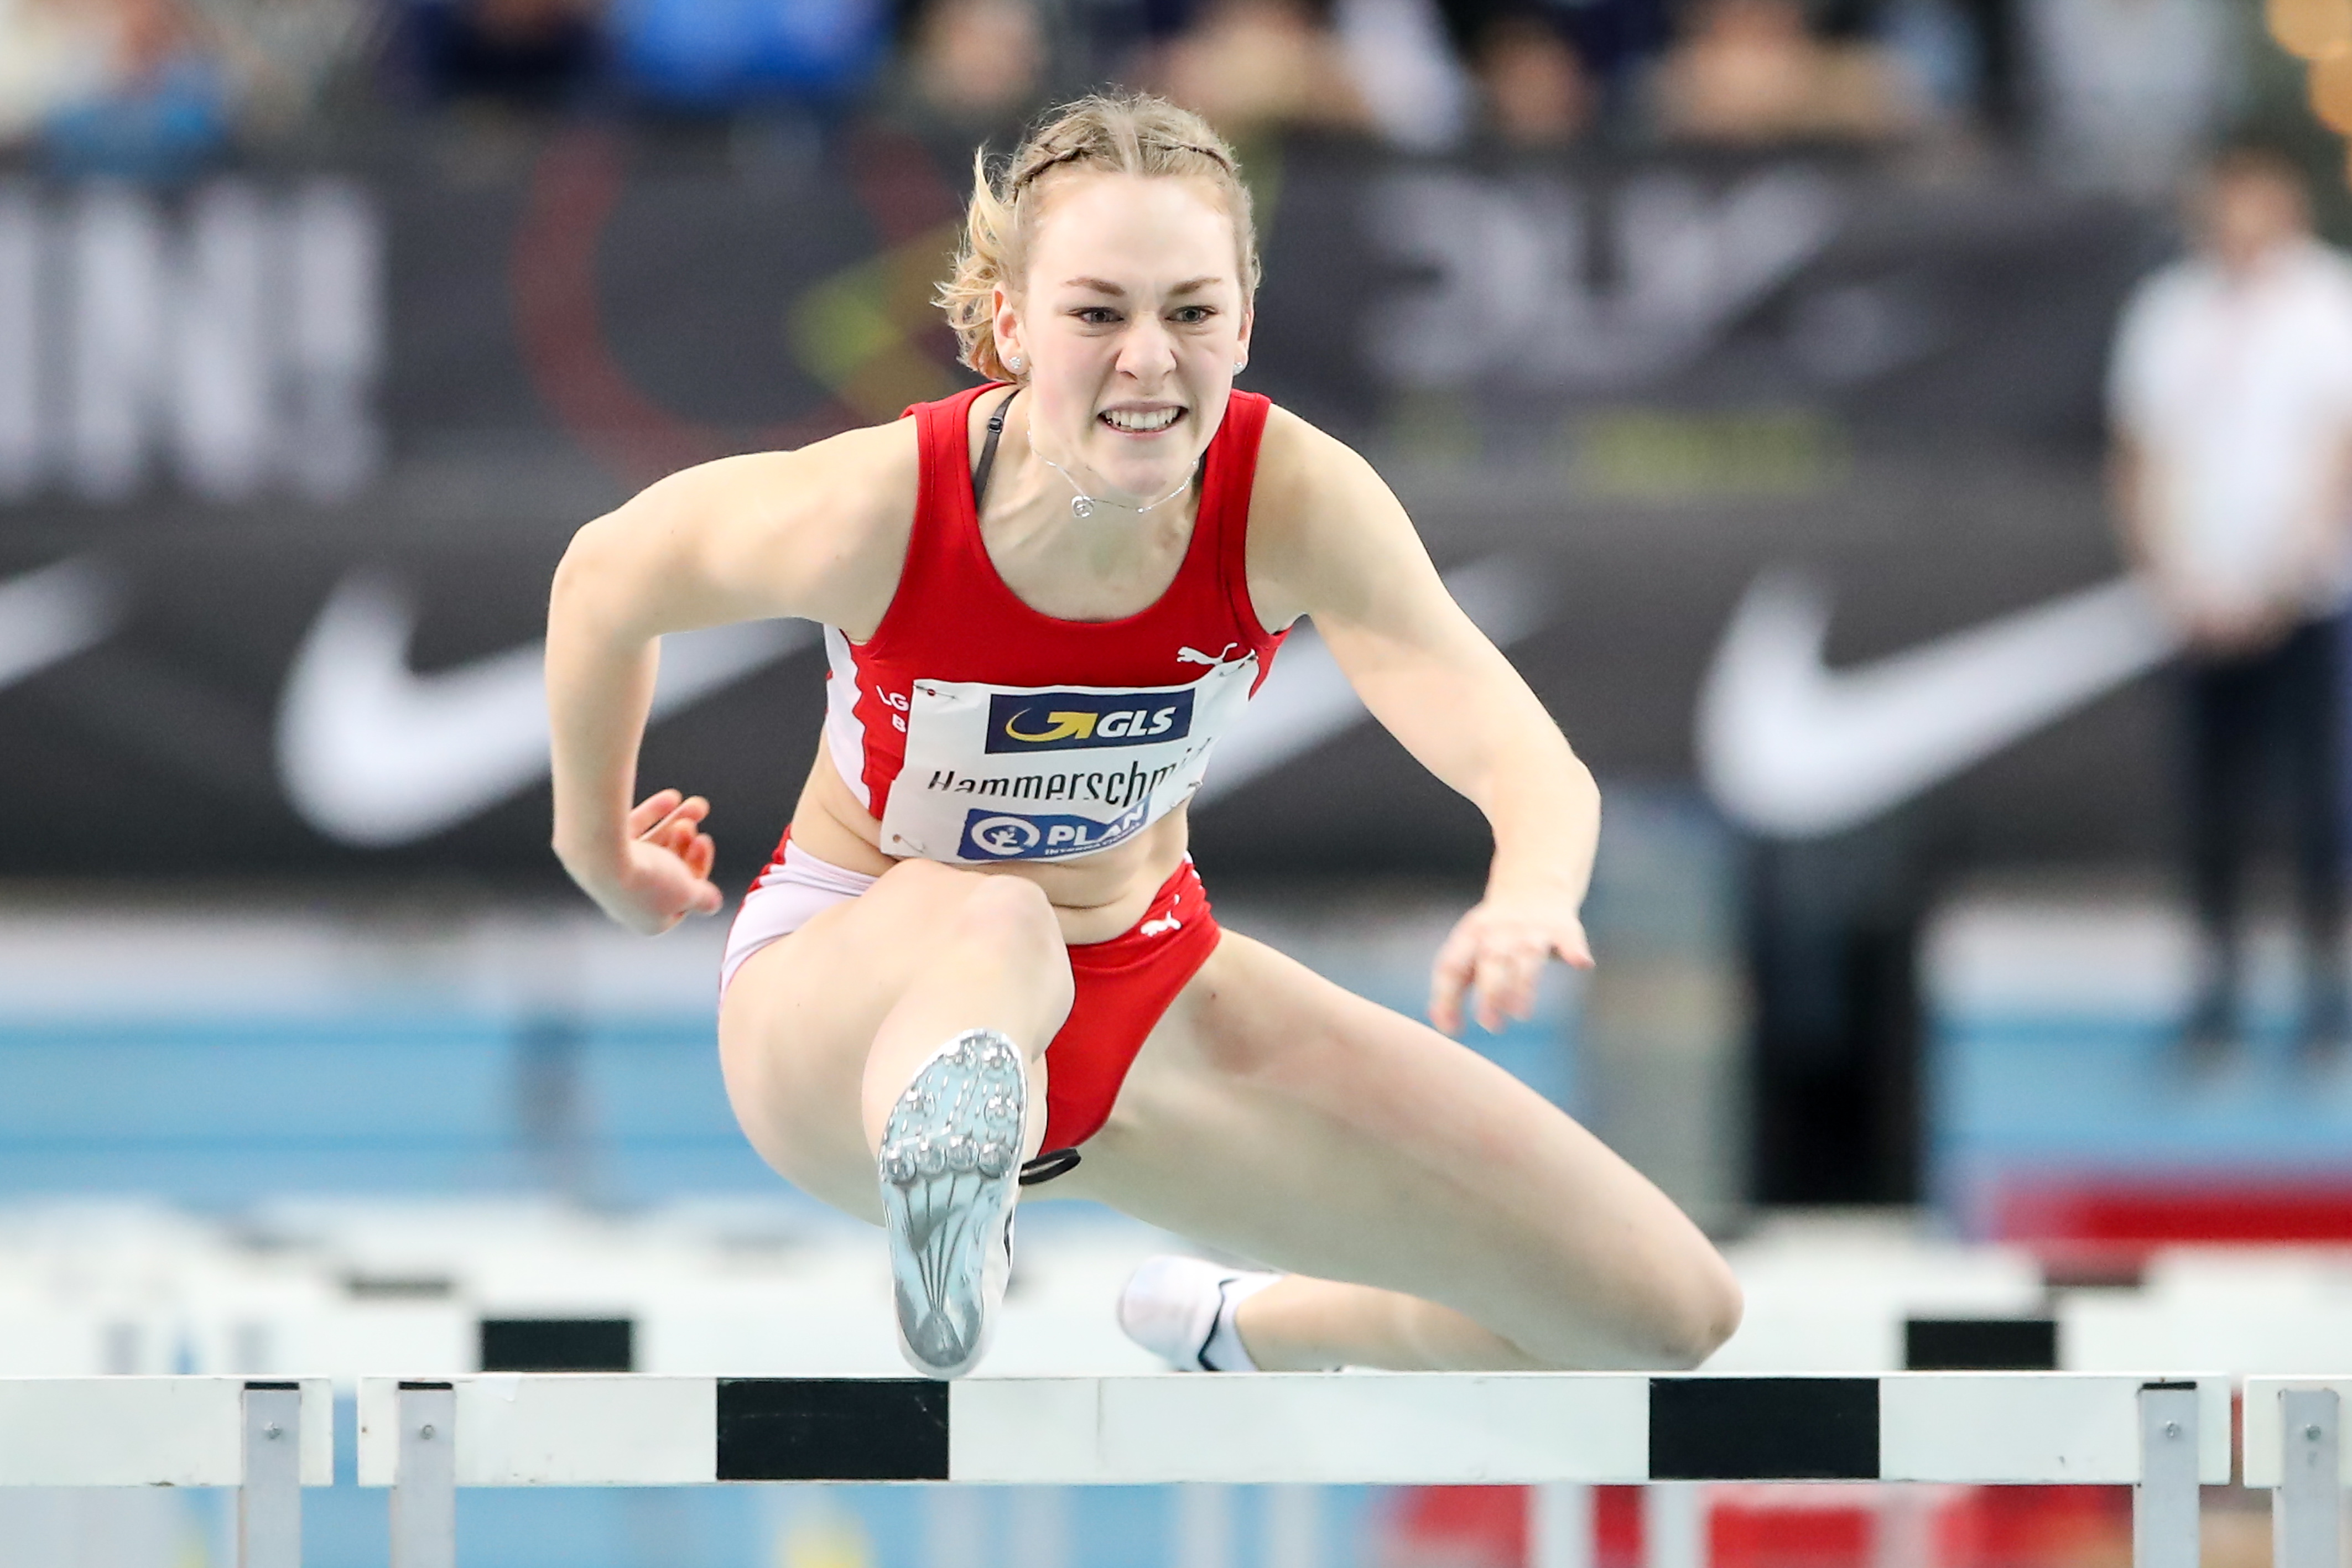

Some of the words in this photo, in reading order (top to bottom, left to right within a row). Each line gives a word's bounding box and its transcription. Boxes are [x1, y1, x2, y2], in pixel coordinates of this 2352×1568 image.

[876, 685, 909, 711] LG
[1096, 707, 1177, 738] GLS
[928, 738, 1211, 807] Hammerschm
